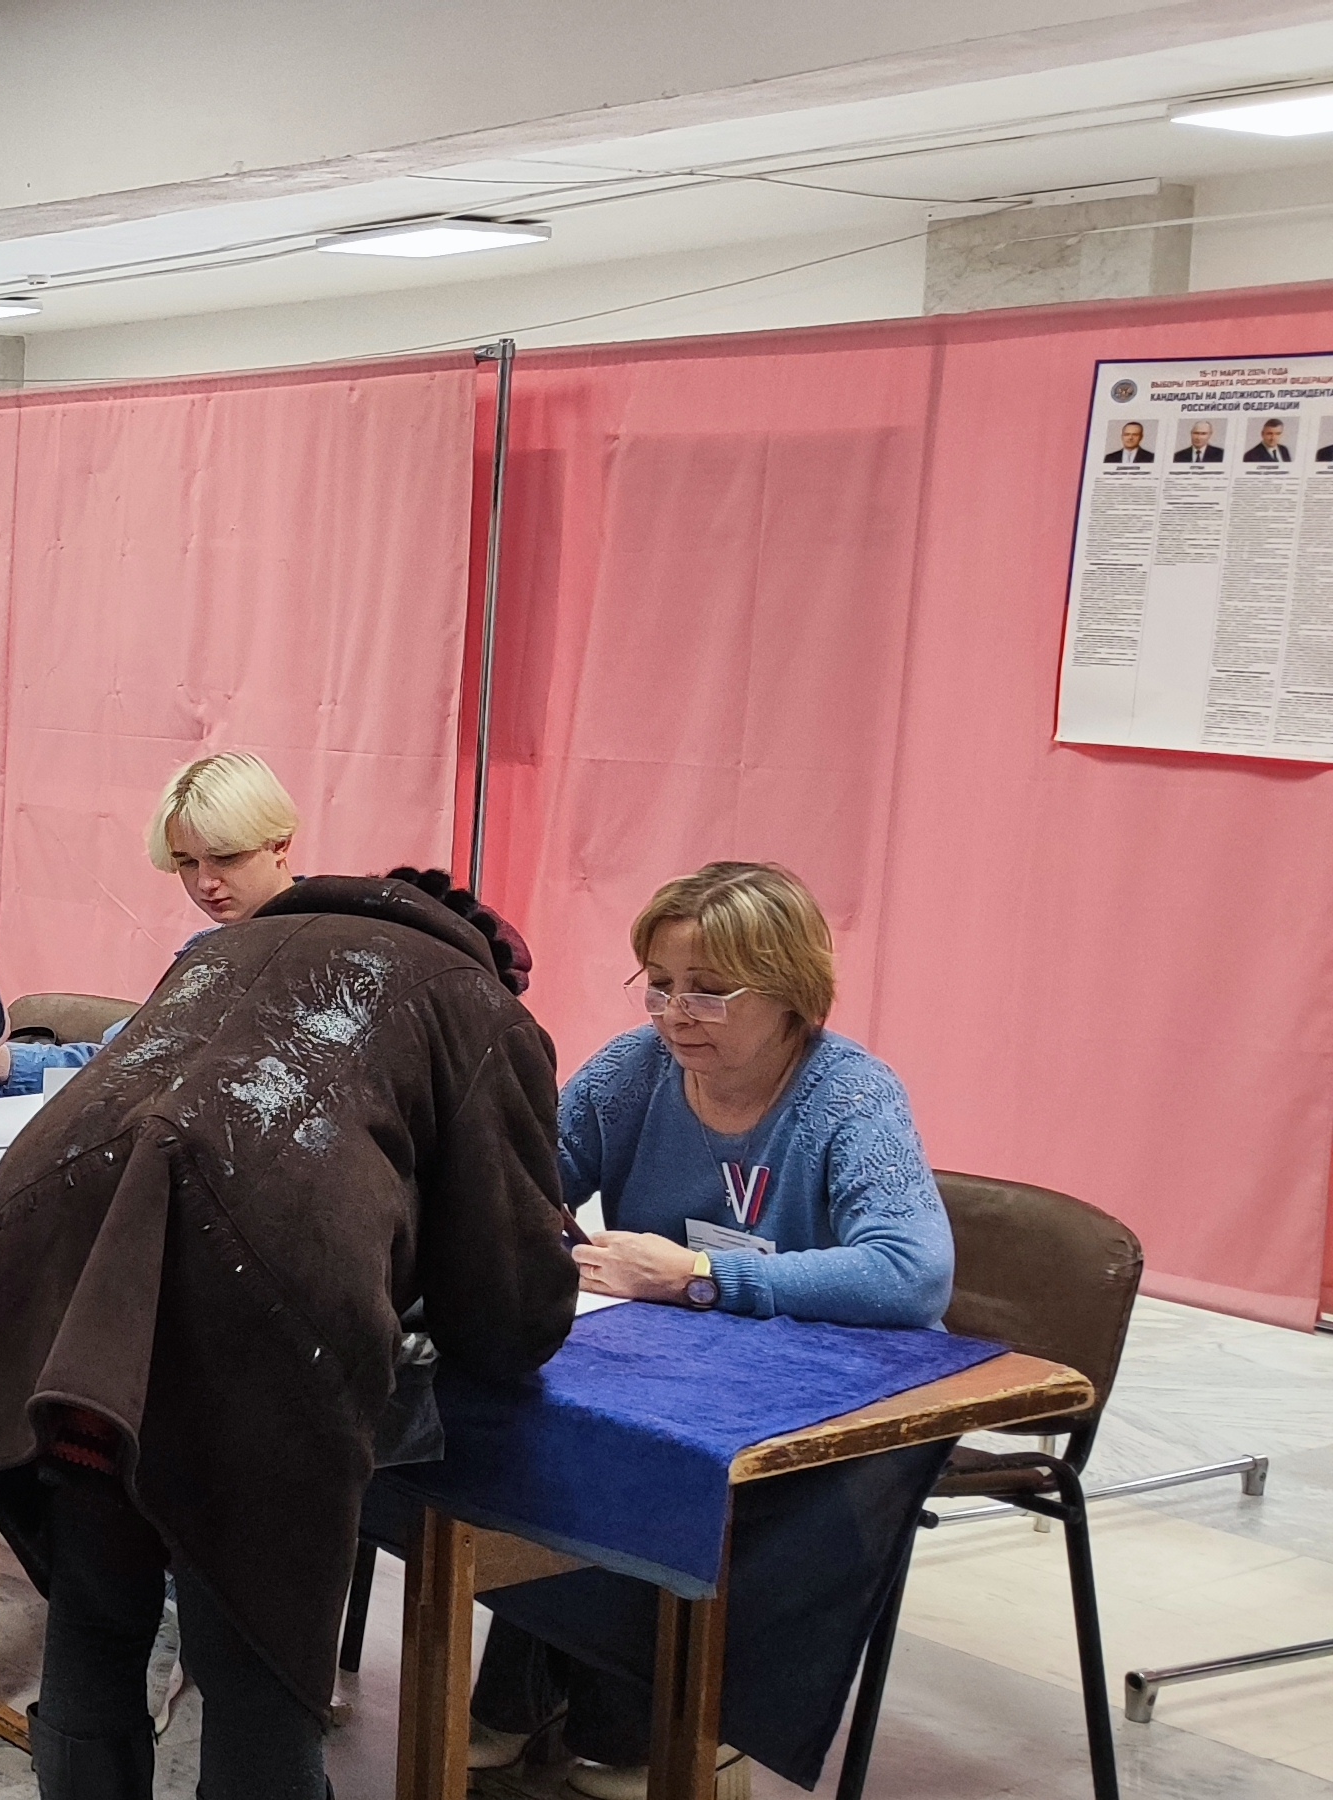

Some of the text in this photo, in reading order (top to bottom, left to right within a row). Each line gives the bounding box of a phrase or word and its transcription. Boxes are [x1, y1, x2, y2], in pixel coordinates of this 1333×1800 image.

[1186, 379, 1234, 387] ПРЕЗИДЕНТА
[1150, 391, 1204, 401] КАНДИДАТЫ
[1205, 391, 1217, 400] НА
[1218, 390, 1275, 400] ДОЛЖНОСТЬ
[1181, 401, 1300, 412] РОССИЙСКОЙ ФЕДЕРАЦИИ
